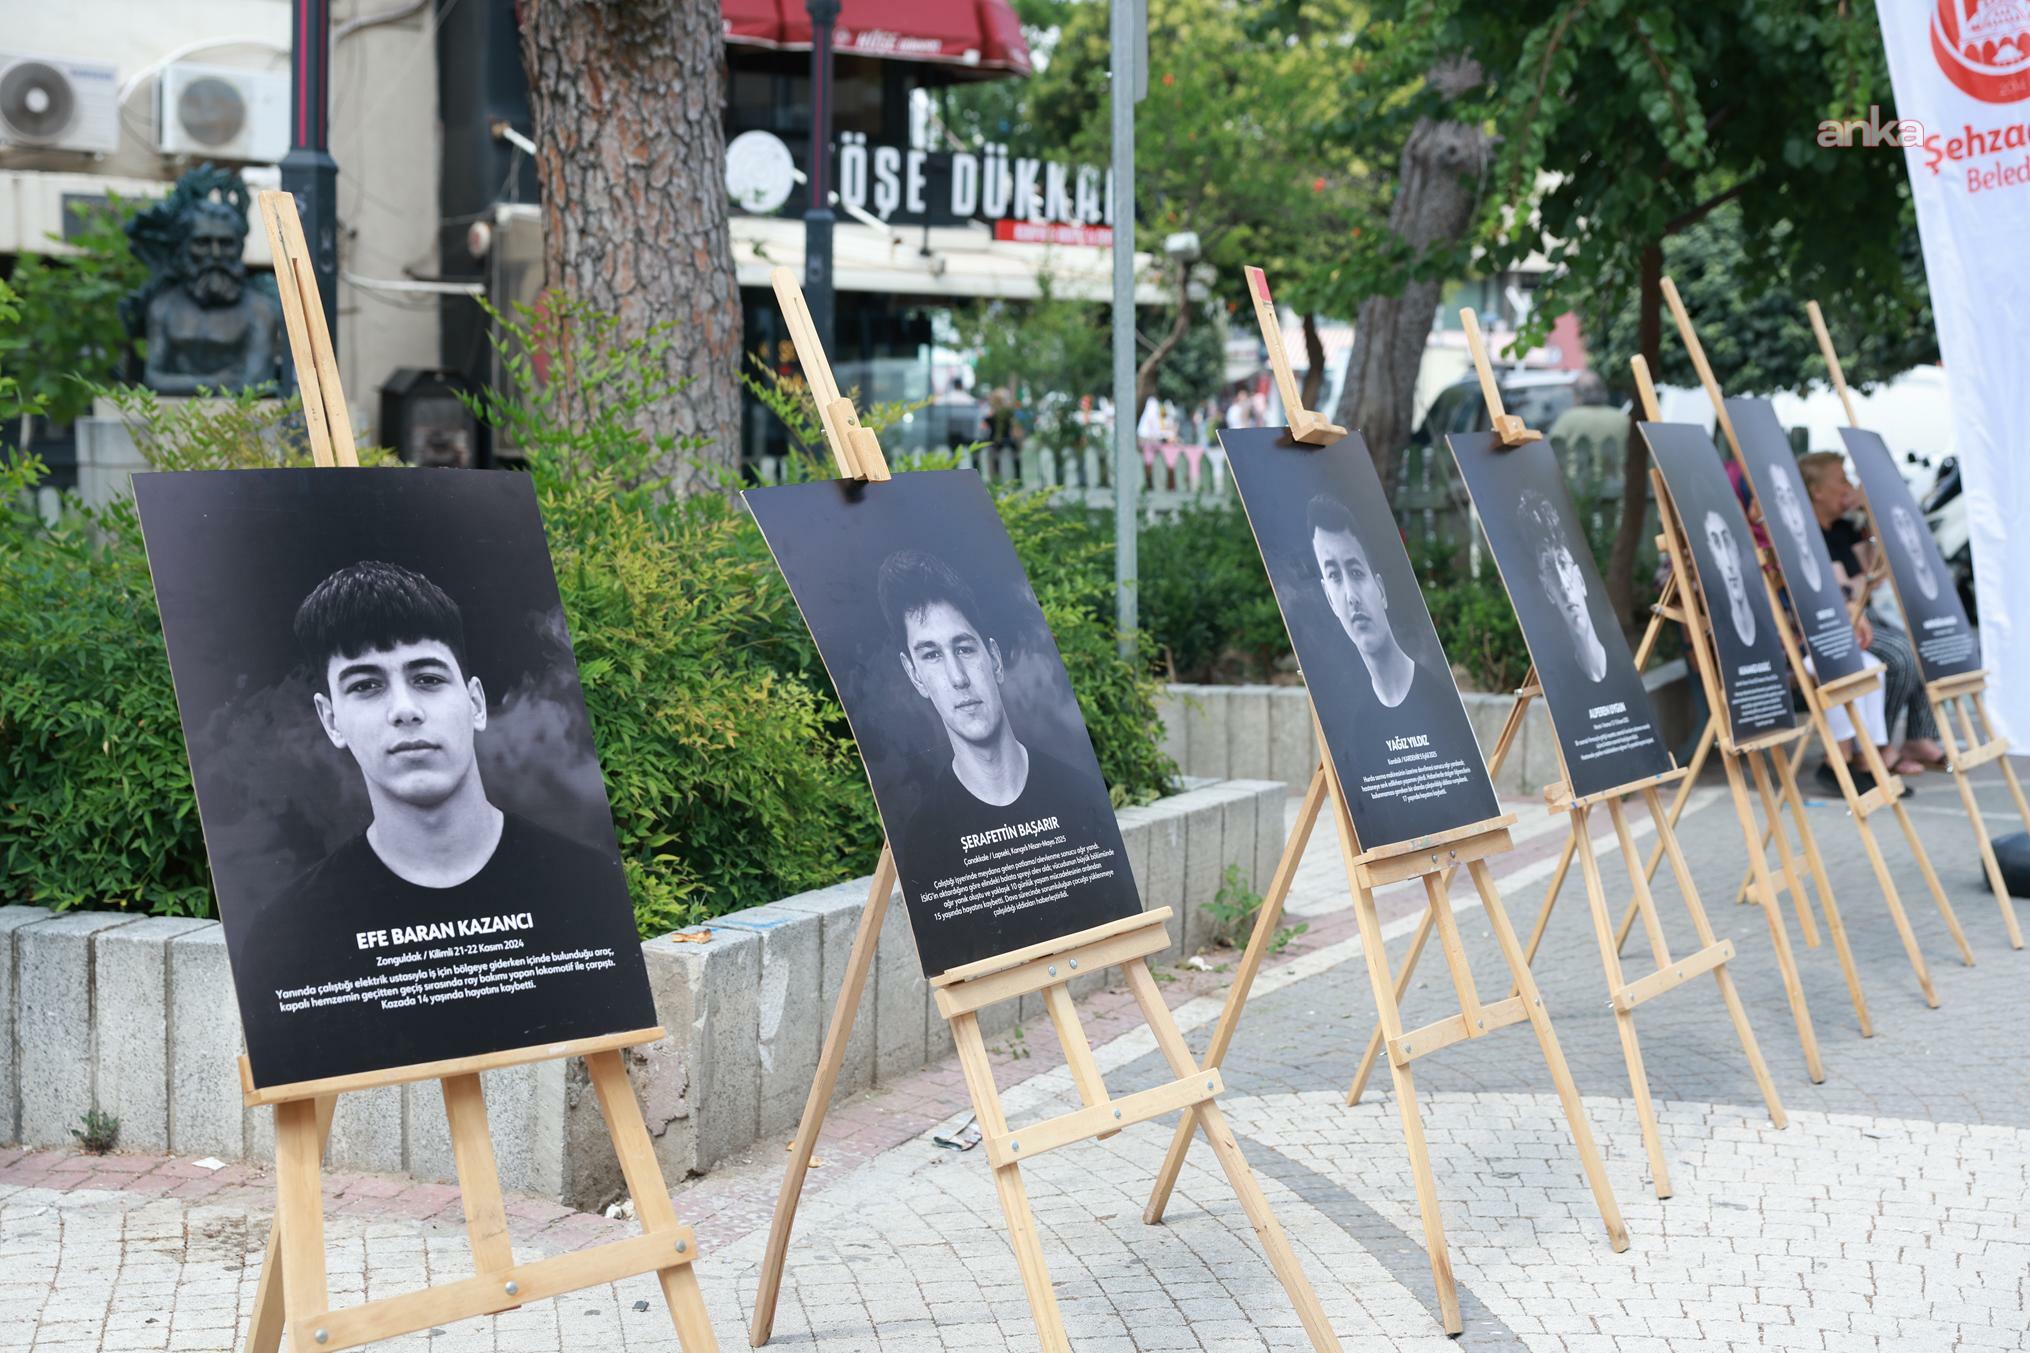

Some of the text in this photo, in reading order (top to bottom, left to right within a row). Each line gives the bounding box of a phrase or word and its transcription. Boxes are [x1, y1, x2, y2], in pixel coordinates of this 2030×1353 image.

[1924, 123, 2030, 174] Şehza
[838, 131, 927, 222] ÖŞE
[1385, 734, 1430, 752] YAĞIZ YILDIZ
[960, 816, 1060, 853] ŞERAFETTİN BAŞARIR
[963, 853, 989, 867] Çanakkale
[991, 848, 1011, 859] Lapseki,
[1054, 835, 1066, 844] 2025
[933, 877, 955, 890] Çalıştığı
[954, 871, 977, 884] işyerinde
[977, 867, 1001, 878] meydana
[1000, 863, 1015, 874] gelen
[1060, 849, 1077, 857] sonucu
[1076, 846, 1086, 855] ağır
[938, 886, 968, 898] aktardığına
[968, 882, 981, 892] göre
[981, 876, 1000, 887] elindeki
[999, 874, 1017, 882] balata
[1031, 867, 1041, 875] alev
[1076, 854, 1090, 864] büyük
[1089, 848, 1114, 860] bölümünde
[934, 912, 942, 920] 15
[941, 906, 962, 920] yaşında
[1004, 894, 1018, 902] Dava
[1018, 887, 1041, 899] sürecinde
[1072, 875, 1089, 886] çocuğa
[943, 899, 954, 908] ağır
[954, 894, 969, 906] yanık
[968, 892, 984, 901] oluştu
[990, 884, 1010, 897] yaklaşık
[1010, 882, 1017, 890] 10
[1017, 878, 1034, 890] günlük
[1033, 876, 1049, 886] yaşam
[356, 912, 533, 949] EFE BARAN KAZANCI
[376, 939, 524, 966] Zonguldak / Kilimli 21-22 Kasım 2024
[275, 948, 614, 999] Yanında çalıştığı elektrik ustasıyla iş için bölgeye giderken içinde bulunduğu araç,
[279, 959, 616, 1012] kapalı hemzemin geçitten geçiş sırasında ray bakımı yapan lokomotif ile çarpıştı.
[381, 979, 536, 1009] Kazada 14 yaşında hayatını kaybetti.
